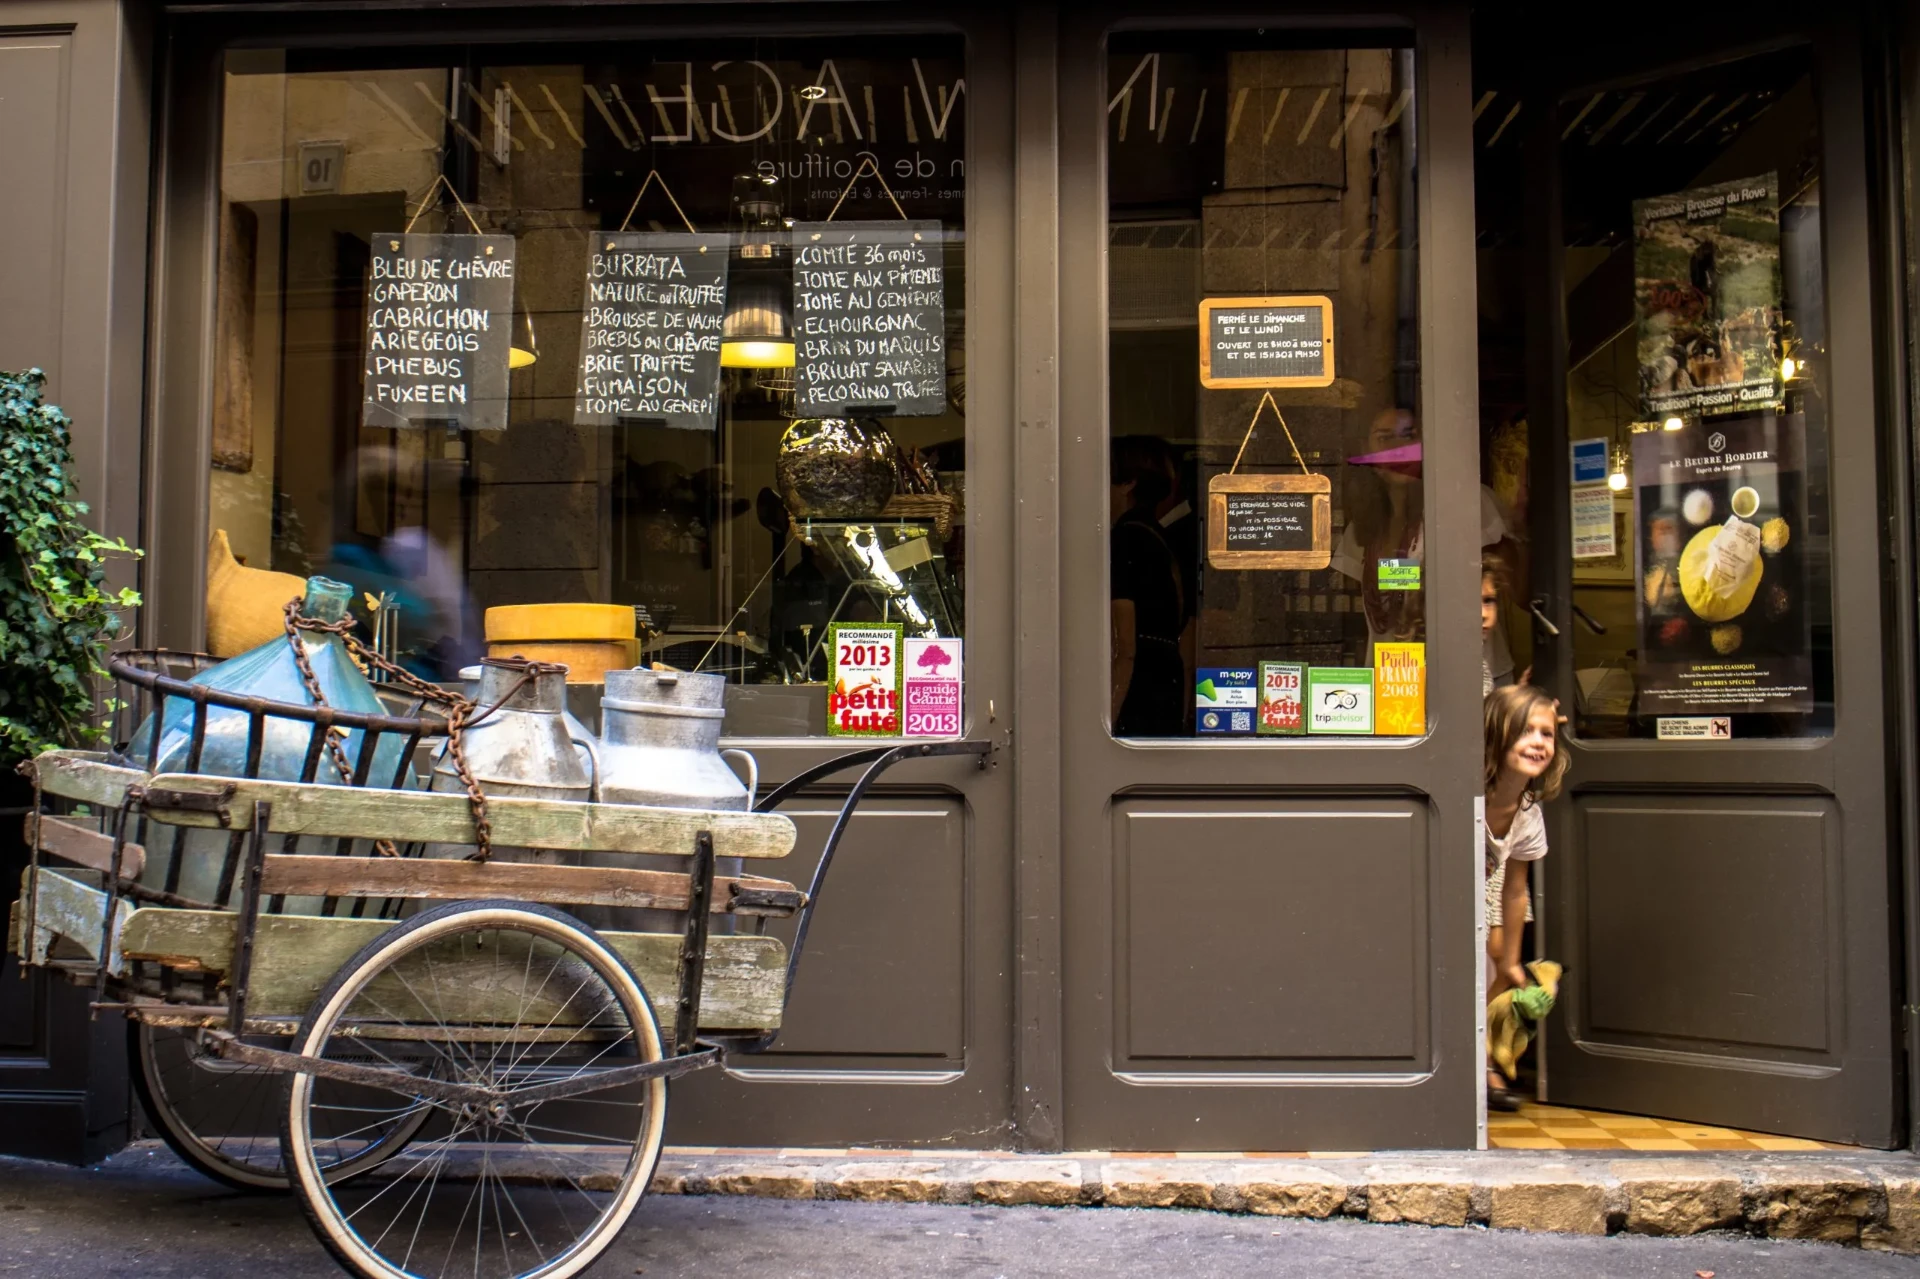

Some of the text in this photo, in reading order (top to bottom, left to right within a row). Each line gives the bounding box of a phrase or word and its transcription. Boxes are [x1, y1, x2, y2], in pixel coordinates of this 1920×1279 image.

[1727, 192, 1739, 203] du
[865, 244, 885, 265] 36
[373, 256, 415, 280] BLEU
[422, 259, 441, 278] DE
[592, 254, 686, 279] BURRATA
[800, 271, 849, 289] TOME
[853, 270, 883, 287] AUX
[374, 283, 458, 302] GAPERON
[590, 282, 658, 303] NATURE
[801, 292, 842, 311] TOME
[848, 291, 872, 310] AU
[590, 307, 659, 328] BROUSSE
[663, 312, 684, 328] DE
[805, 313, 927, 335] ECHOURGNAC
[1249, 315, 1260, 323] LE
[1224, 323, 1283, 334] ET LE LUNDI
[588, 330, 641, 349] BREBIS
[857, 339, 875, 354] DU
[1217, 341, 1251, 349] OUVERT
[1258, 341, 1268, 349] DE
[376, 357, 461, 377] PHEBUS
[585, 350, 624, 373] BRIE
[377, 384, 466, 404] FUXEEN
[808, 383, 889, 404] PECORINO
[1650, 385, 1774, 412] Tradition Passion Qualité
[585, 398, 632, 413] TOME
[637, 399, 660, 412] AU
[1725, 451, 1769, 463] BORDIER
[840, 645, 891, 666] 2013
[1381, 651, 1418, 668] Pudlo
[1266, 674, 1298, 688] 2013
[1380, 666, 1419, 683] FRANCE
[1382, 683, 1419, 697] 2008
[829, 688, 898, 715] petit
[1260, 701, 1302, 715] petit
[841, 709, 898, 731] futé
[908, 714, 957, 732] 2013
[1315, 713, 1364, 724] tripadvisor
